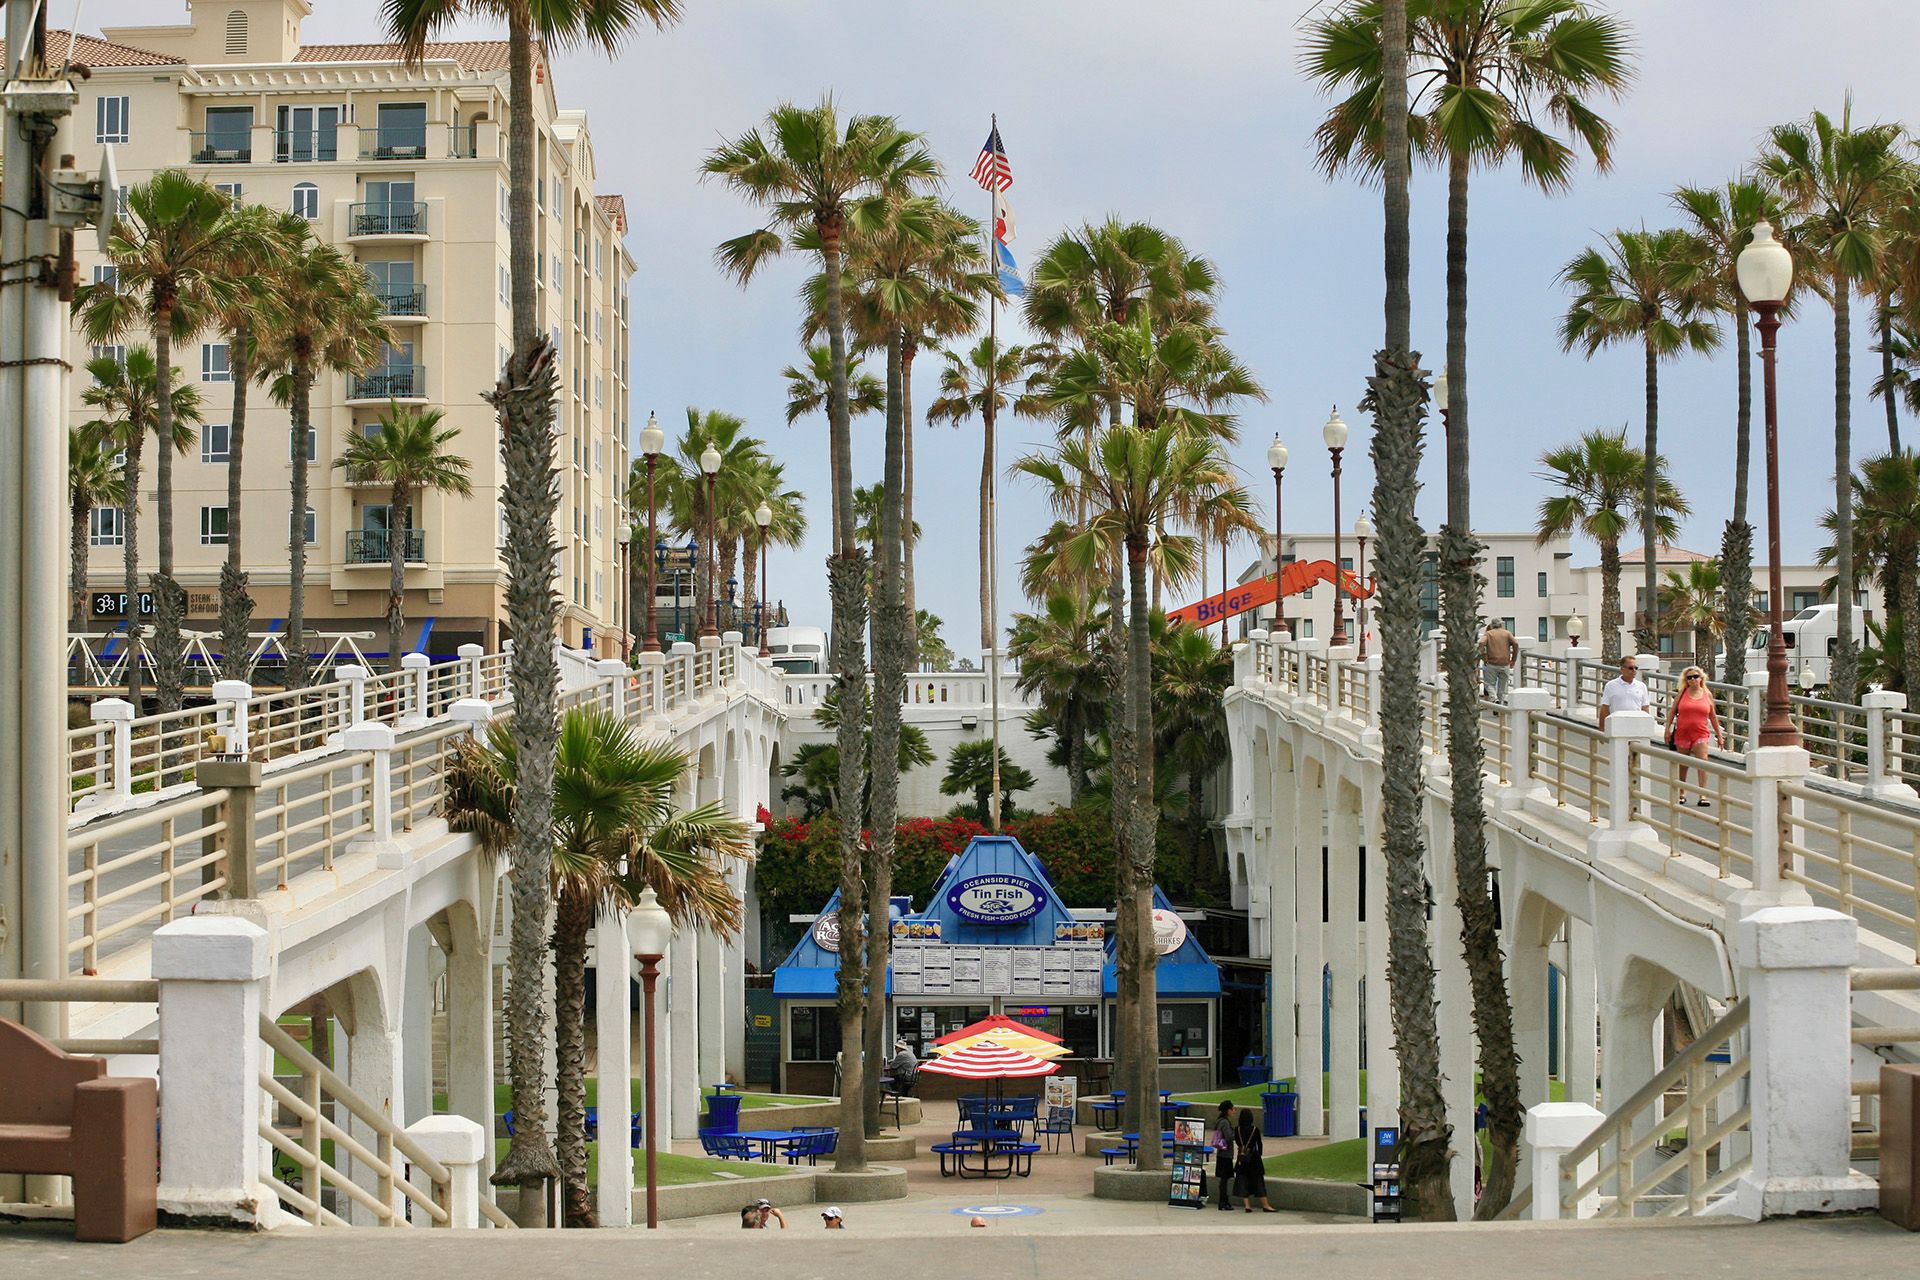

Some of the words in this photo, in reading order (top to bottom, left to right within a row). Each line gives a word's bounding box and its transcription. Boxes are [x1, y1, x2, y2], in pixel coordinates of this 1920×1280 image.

[190, 593, 211, 603] STEAK
[190, 603, 219, 613] SEAFOOD
[963, 877, 1009, 889] OCEANSIDE
[1011, 877, 1030, 889] PIER
[971, 889, 992, 899] Tin
[995, 889, 1024, 899] Fish
[958, 907, 979, 919] FRESH
[1019, 906, 1036, 918] FOOD
